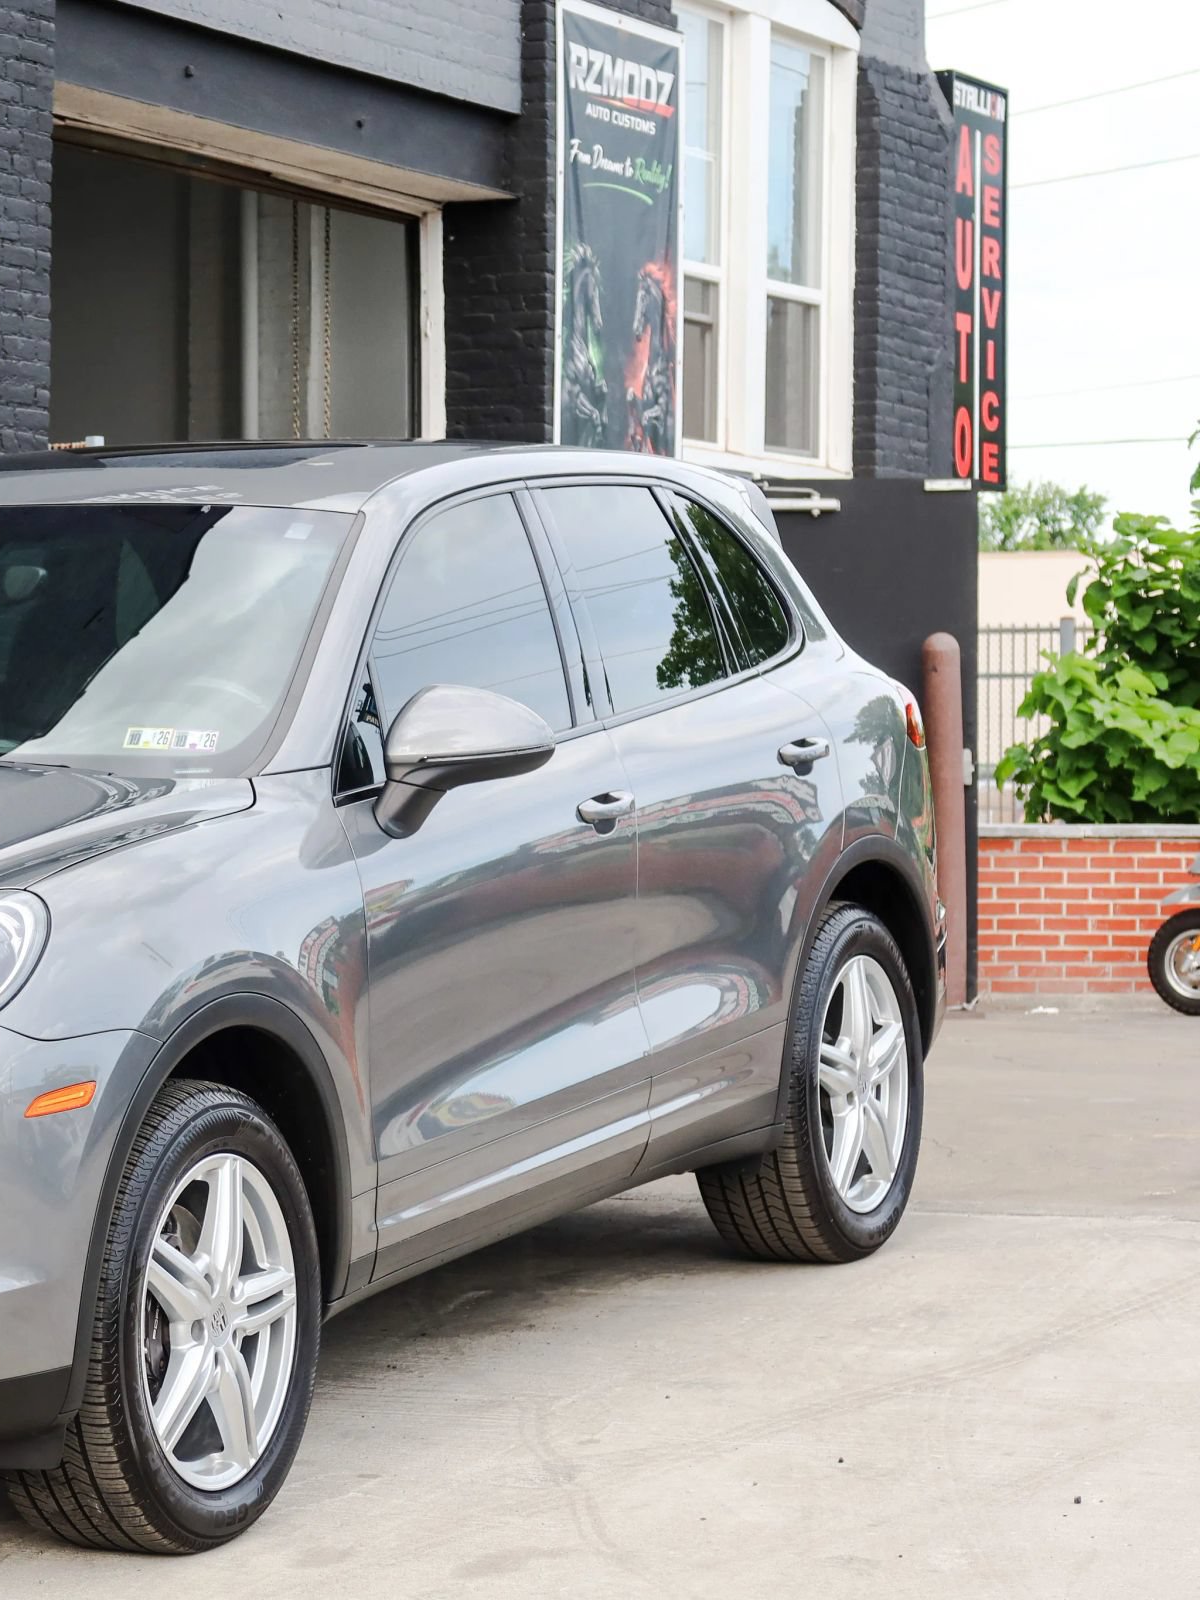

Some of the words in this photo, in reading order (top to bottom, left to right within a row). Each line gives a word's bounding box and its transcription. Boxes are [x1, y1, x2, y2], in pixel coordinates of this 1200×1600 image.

[568, 41, 675, 118] RZMODZ
[953, 79, 1006, 122] STALLION
[585, 103, 610, 122] AUTO
[611, 113, 657, 135] CUSTOMS
[569, 138, 591, 165] From
[623, 156, 634, 177] to
[954, 124, 974, 478] AUTO
[981, 133, 1003, 483] SERVICE
